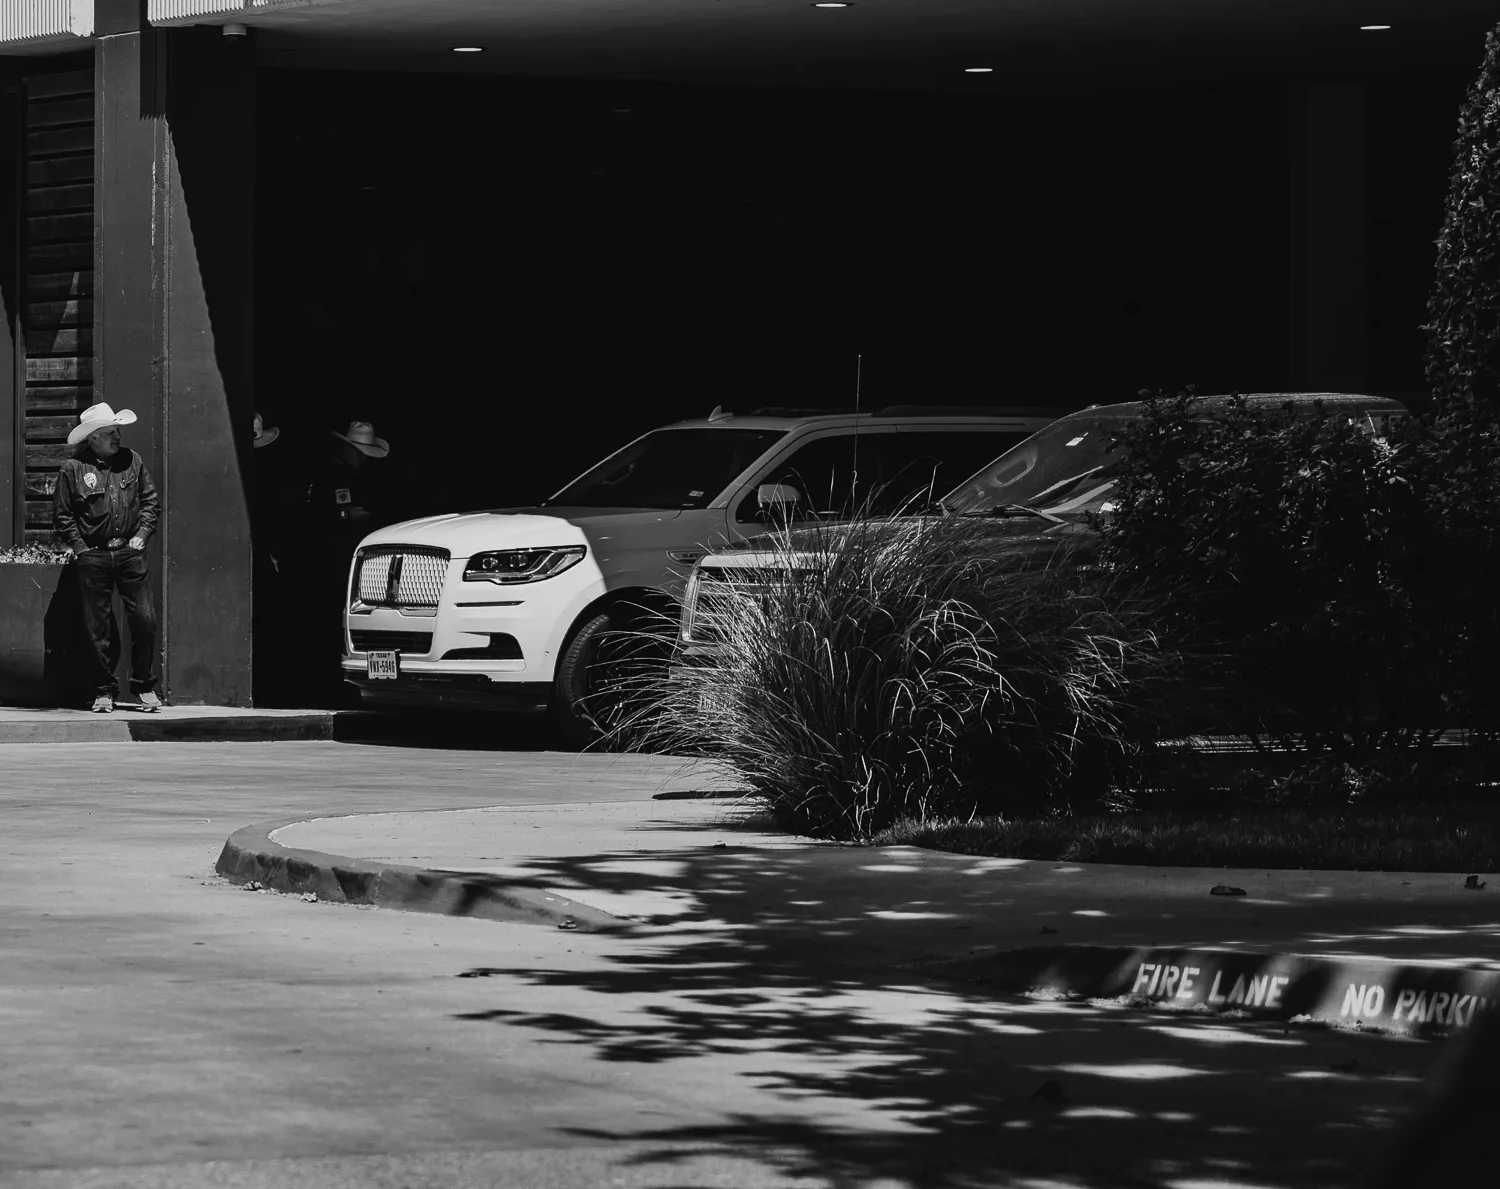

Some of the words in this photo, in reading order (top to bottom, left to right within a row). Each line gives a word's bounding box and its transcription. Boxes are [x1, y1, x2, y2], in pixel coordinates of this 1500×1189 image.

[1131, 962, 1200, 999] FIRE
[1207, 969, 1290, 1008] LANE
[1339, 982, 1386, 1018] NO
